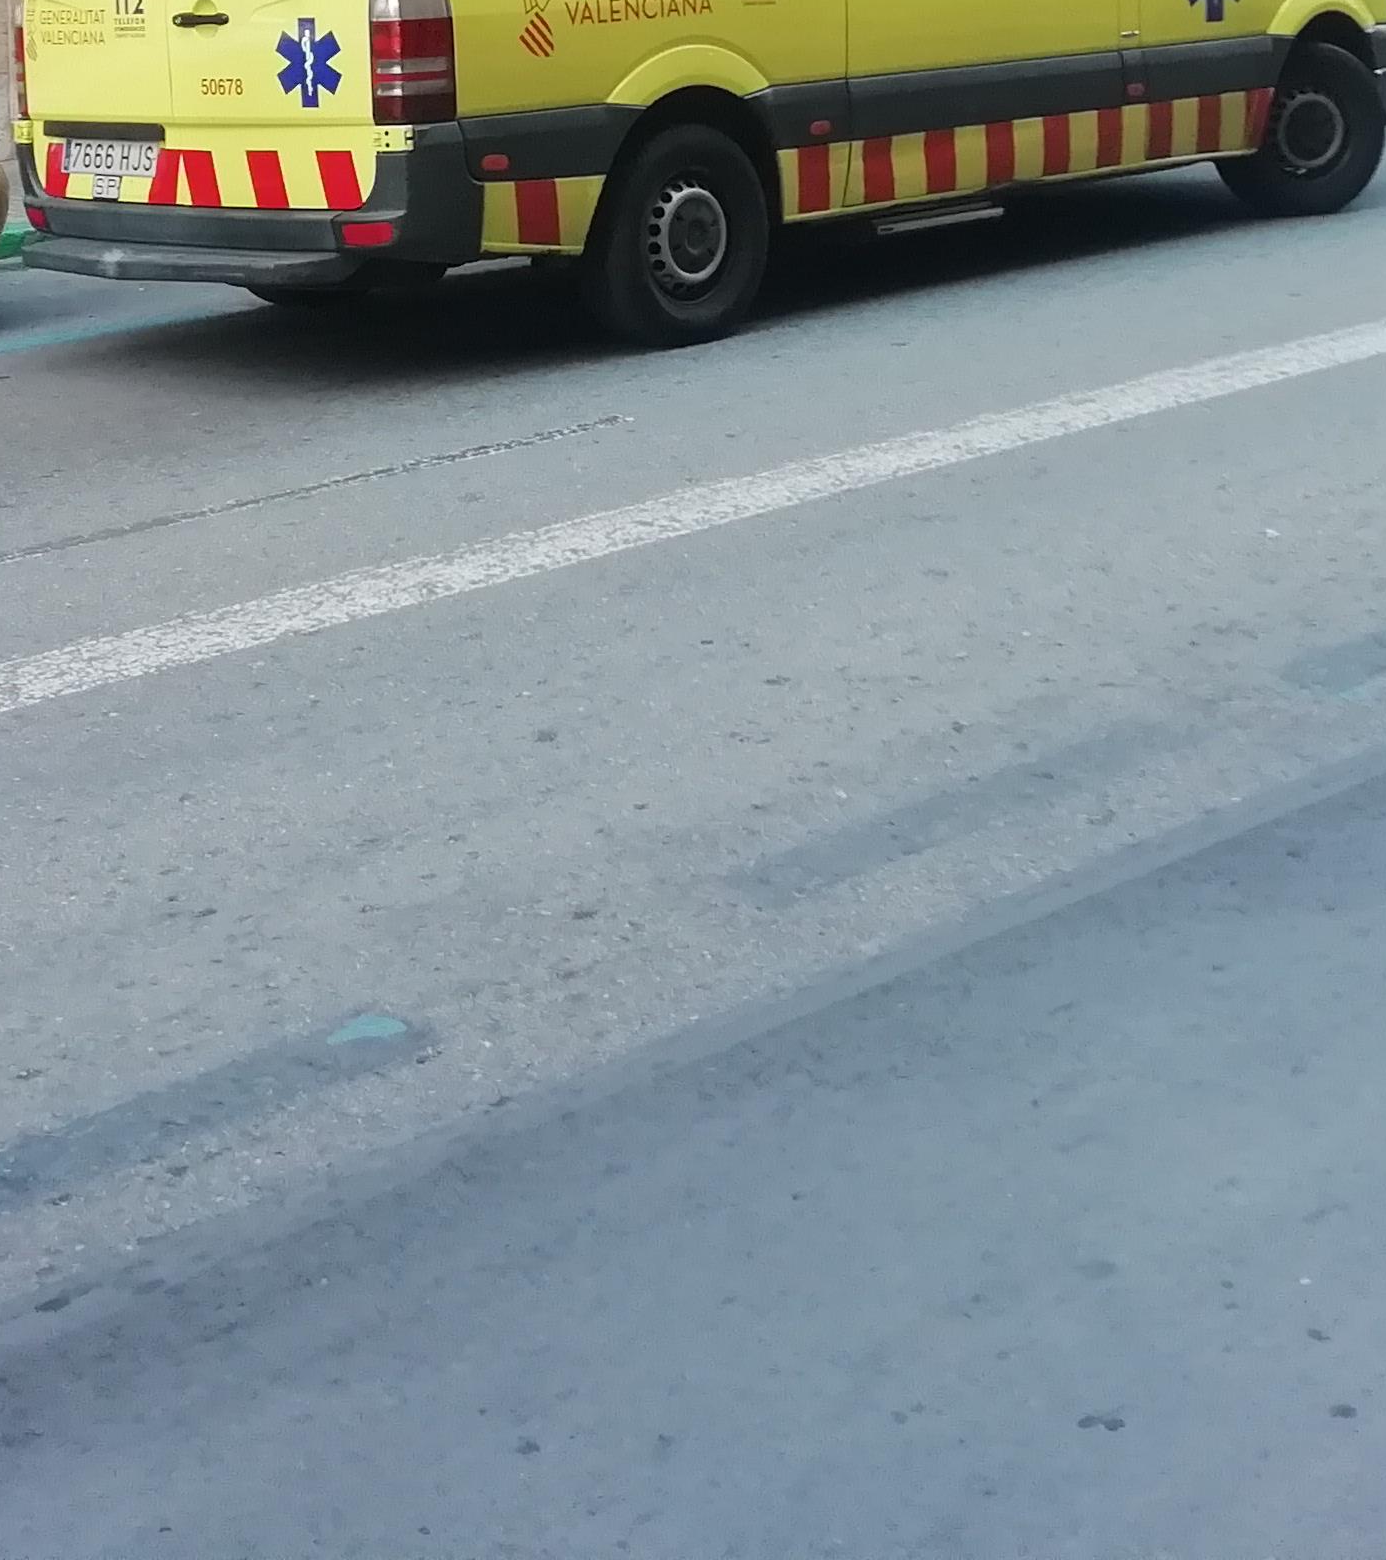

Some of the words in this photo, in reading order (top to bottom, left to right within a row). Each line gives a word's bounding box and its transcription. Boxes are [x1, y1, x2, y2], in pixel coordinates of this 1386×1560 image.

[39, 9, 106, 25] GENERALITAT
[40, 30, 106, 46] VALENCIANA
[200, 78, 244, 97] 50678
[72, 142, 114, 170] 7666
[119, 144, 154, 172] HJS
[94, 178, 117, 196] SP
